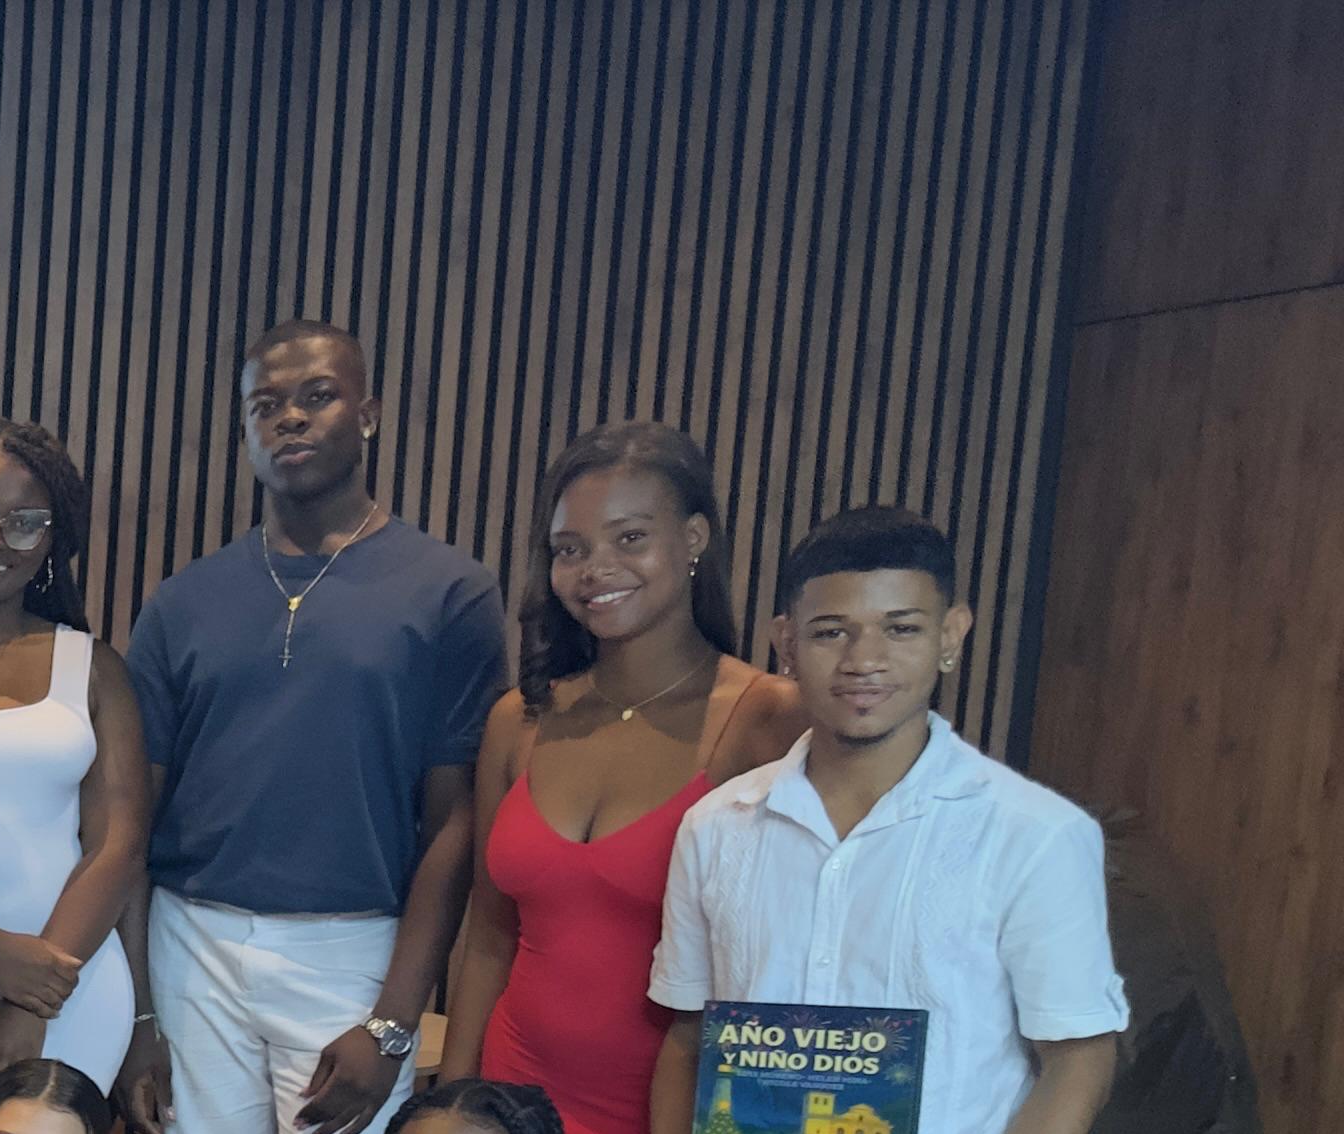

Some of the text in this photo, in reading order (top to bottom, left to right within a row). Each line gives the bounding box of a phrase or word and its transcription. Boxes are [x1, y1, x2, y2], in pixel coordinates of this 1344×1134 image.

[717, 1019, 887, 1053] AÑO VIEJO
[739, 1049, 808, 1071] NIÑO
[813, 1053, 880, 1075] DIOS
